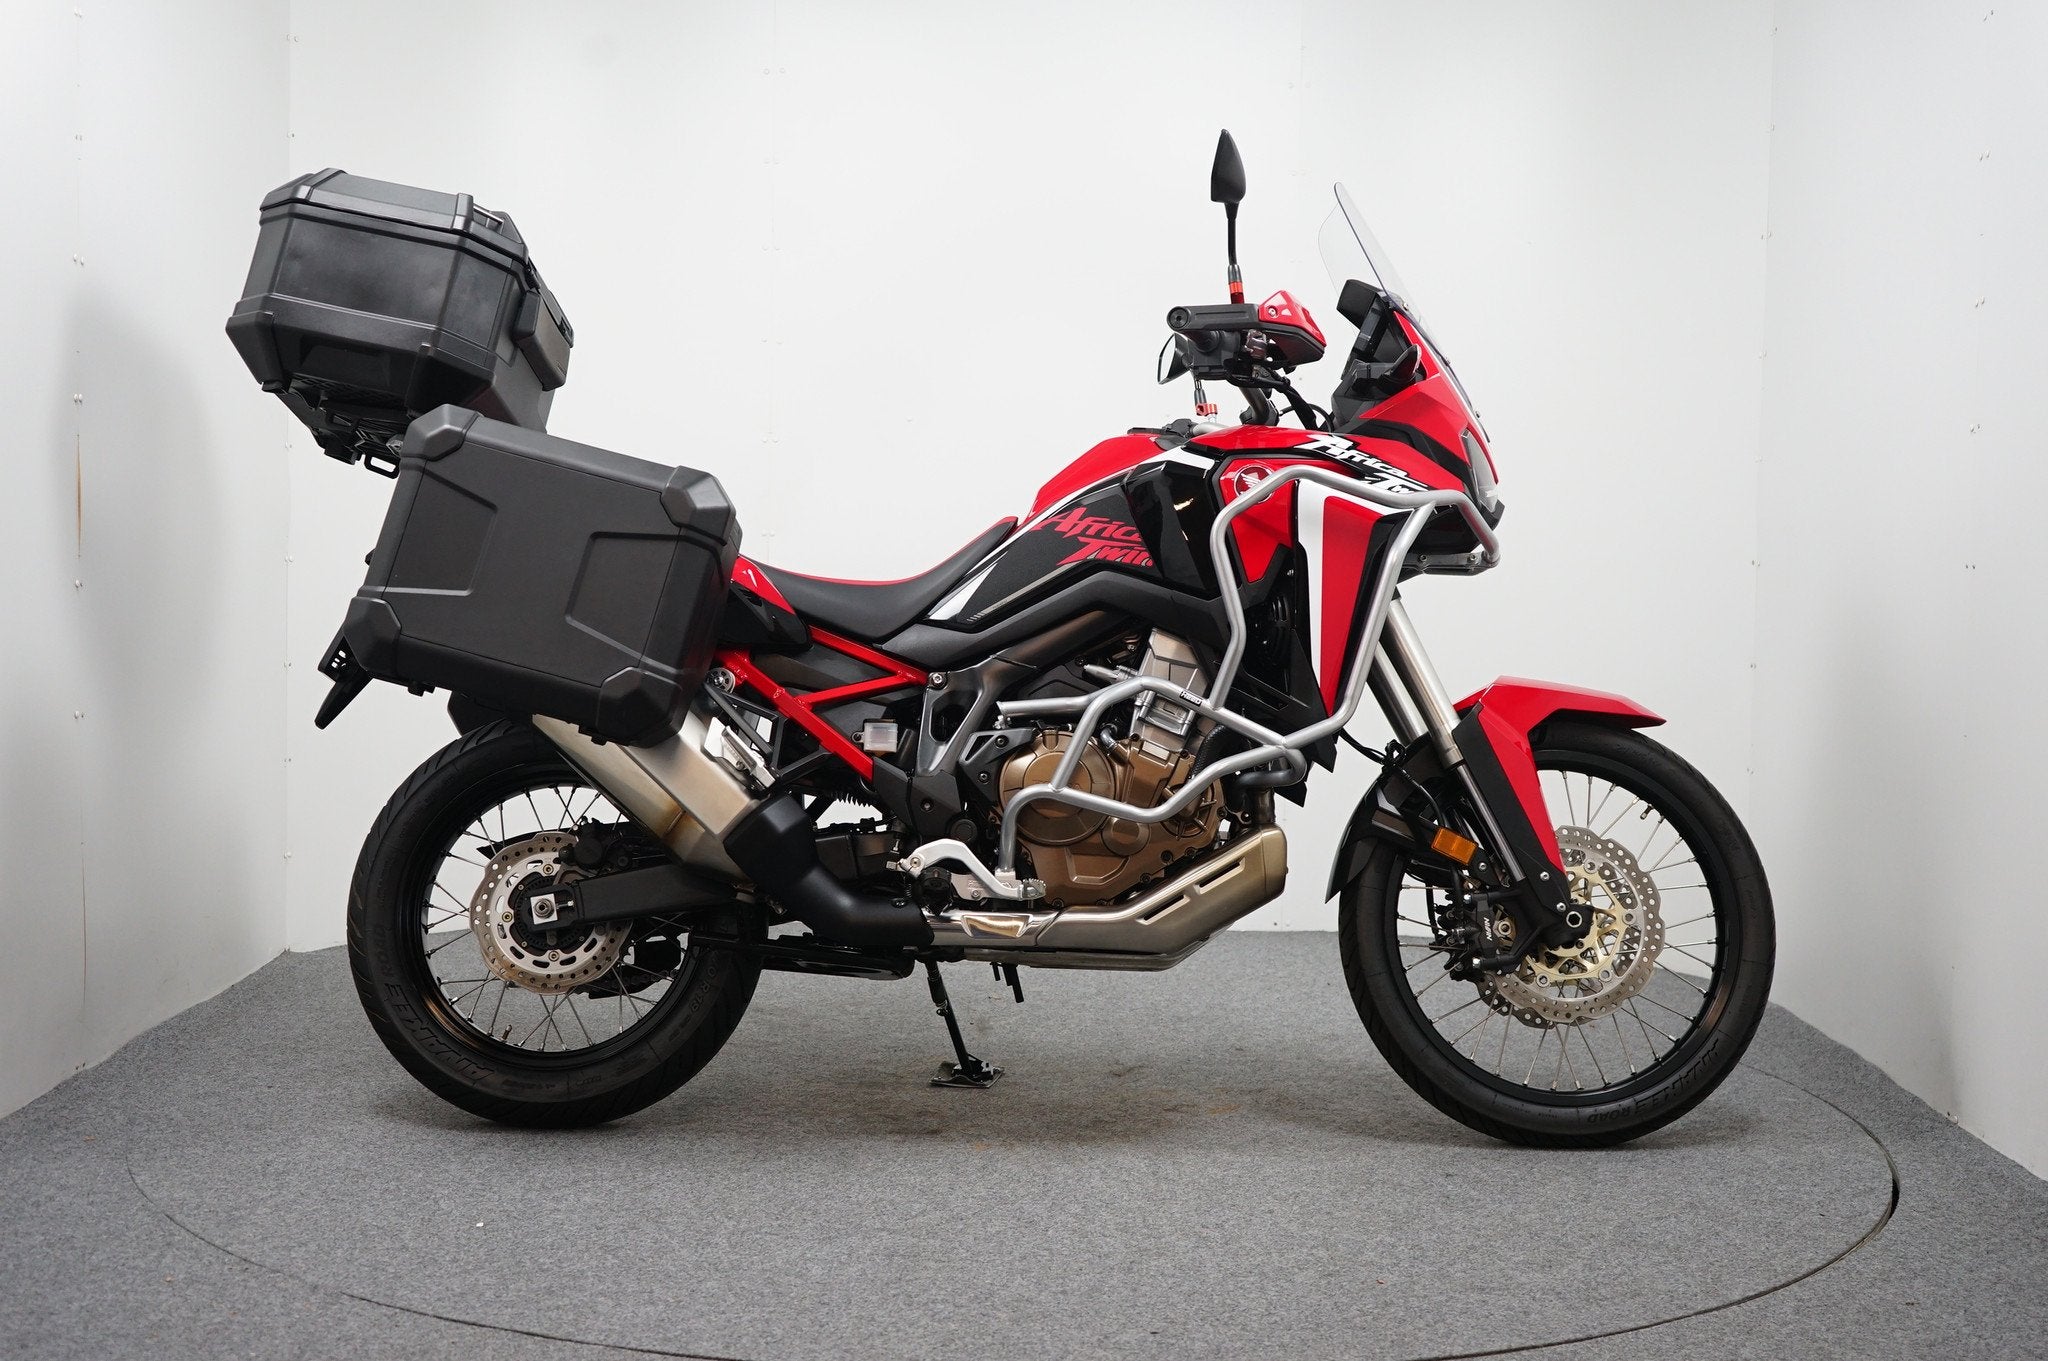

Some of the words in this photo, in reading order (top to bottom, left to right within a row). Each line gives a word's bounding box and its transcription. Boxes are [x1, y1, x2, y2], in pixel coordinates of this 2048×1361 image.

[1293, 434, 1409, 479] Africa
[383, 983, 497, 1087] ANAKEE
[1587, 1105, 1631, 1123] ROAD
